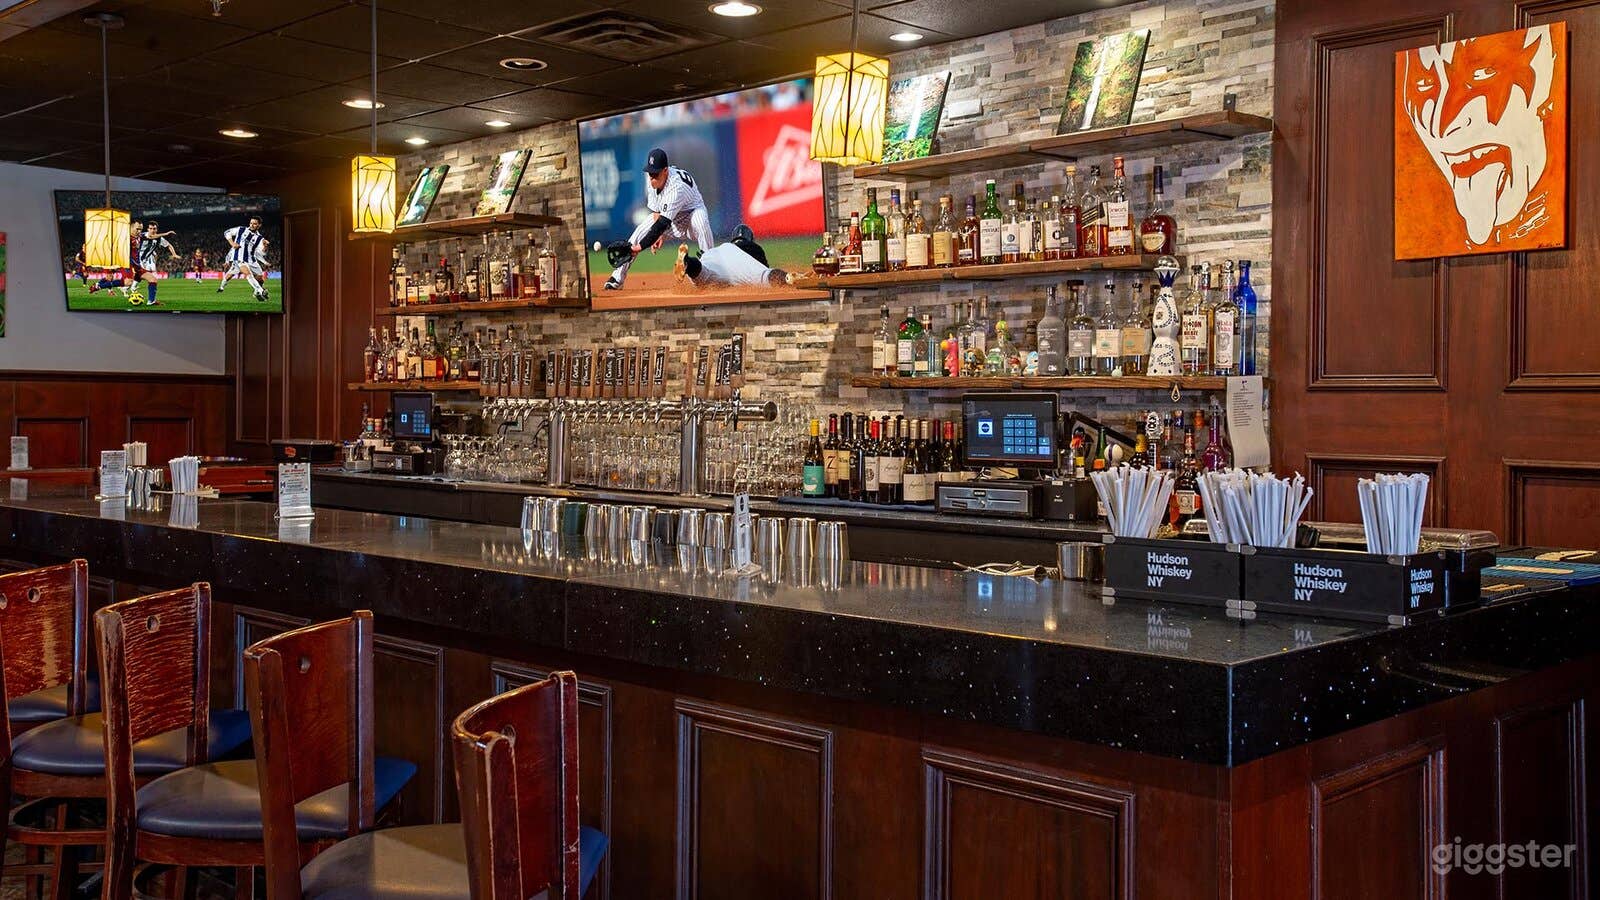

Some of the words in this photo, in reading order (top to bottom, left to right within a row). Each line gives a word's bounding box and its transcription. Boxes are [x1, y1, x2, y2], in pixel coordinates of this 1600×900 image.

[1147, 552, 1188, 566] Hudson
[1147, 564, 1192, 581] Whiskey
[1294, 564, 1343, 578] Hudson
[1410, 568, 1432, 582] Hudson
[1147, 576, 1163, 588] NY
[1294, 576, 1348, 593] Whiskey
[1410, 582, 1434, 595] Whiskey
[1294, 588, 1314, 601] NY
[1411, 595, 1421, 607] NY
